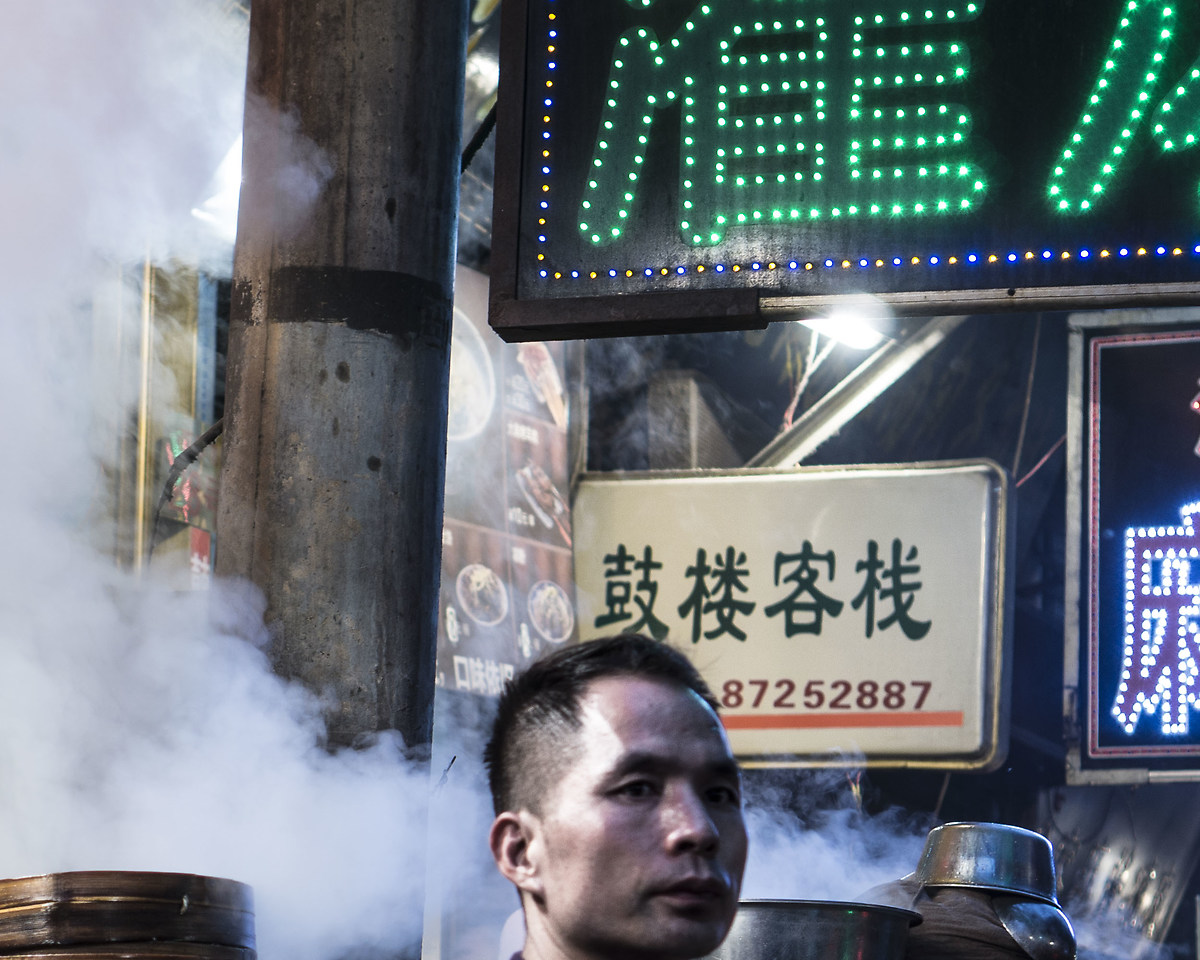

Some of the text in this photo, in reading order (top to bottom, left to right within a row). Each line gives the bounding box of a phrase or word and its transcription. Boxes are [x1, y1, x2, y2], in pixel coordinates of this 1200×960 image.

[594, 537, 932, 643] 鼓楼客栈
[722, 679, 932, 710] 87252887
